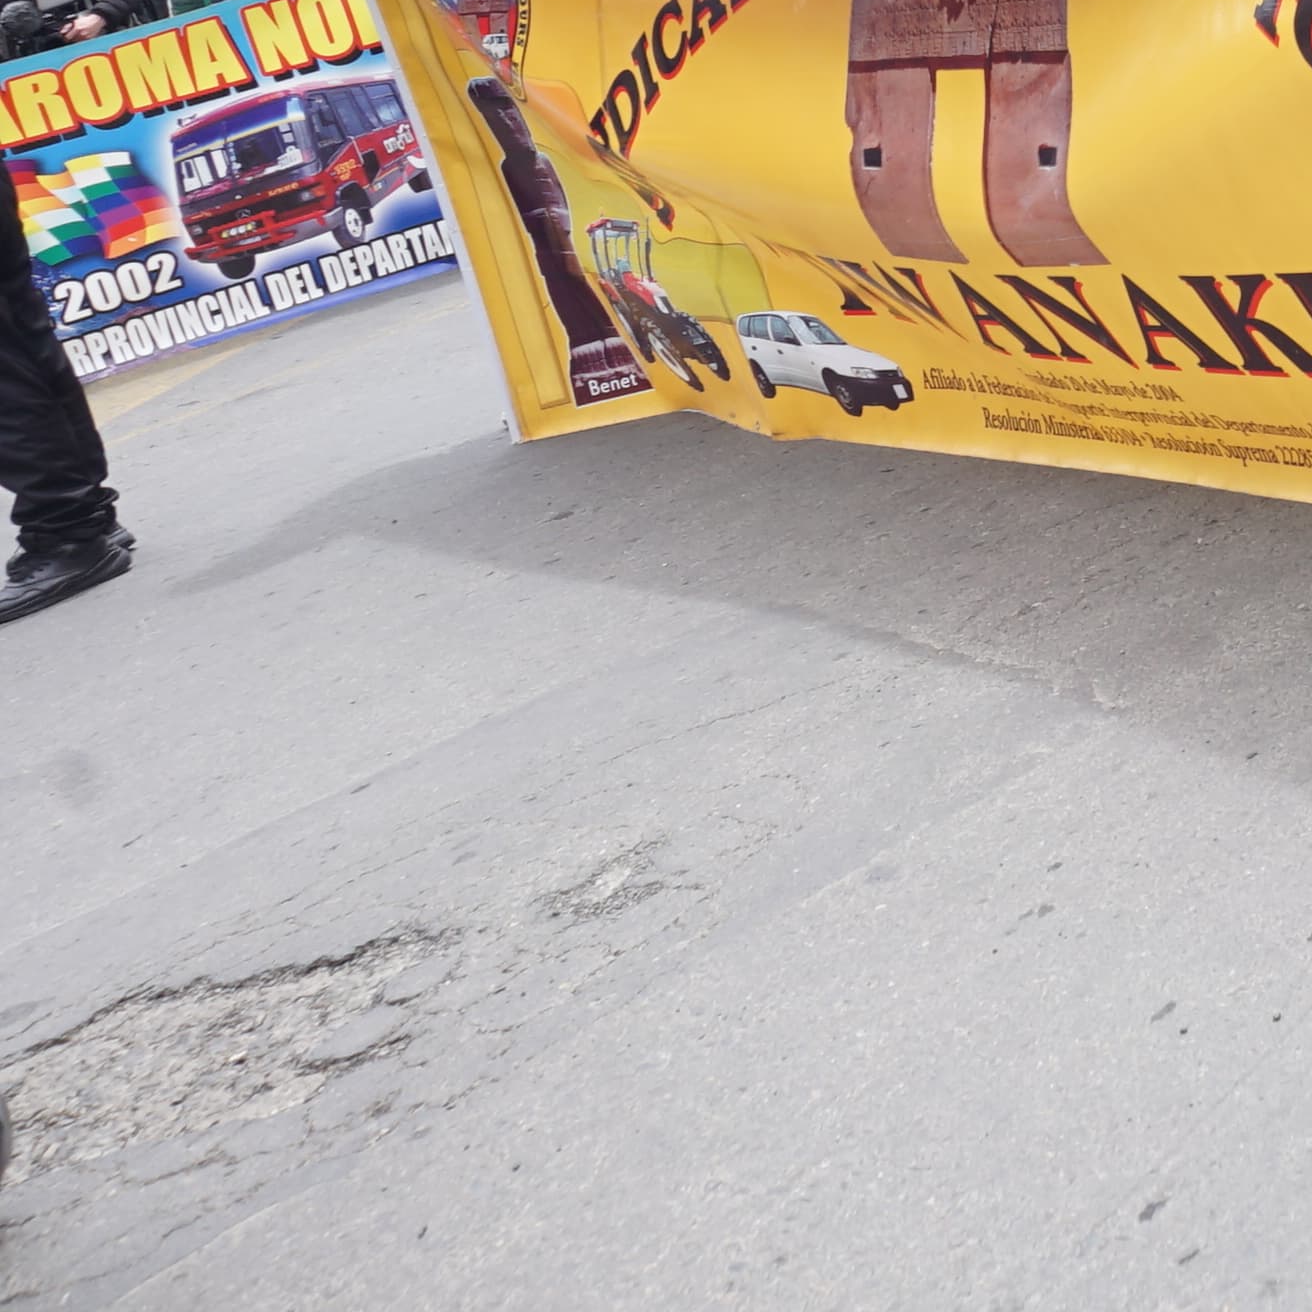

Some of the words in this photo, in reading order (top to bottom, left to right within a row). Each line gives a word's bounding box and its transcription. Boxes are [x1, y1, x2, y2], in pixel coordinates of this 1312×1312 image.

[0, 16, 252, 149] ROMA
[53, 251, 183, 325] 2002
[62, 278, 270, 377] RPROVINCIAL
[267, 265, 327, 318] DEL
[587, 372, 639, 397] Benet
[922, 367, 966, 391] Afiliado
[973, 375, 985, 394] la
[982, 406, 1042, 435] Resolución
[1041, 413, 1105, 442] Ministerial
[1222, 438, 1279, 469] Suprema
